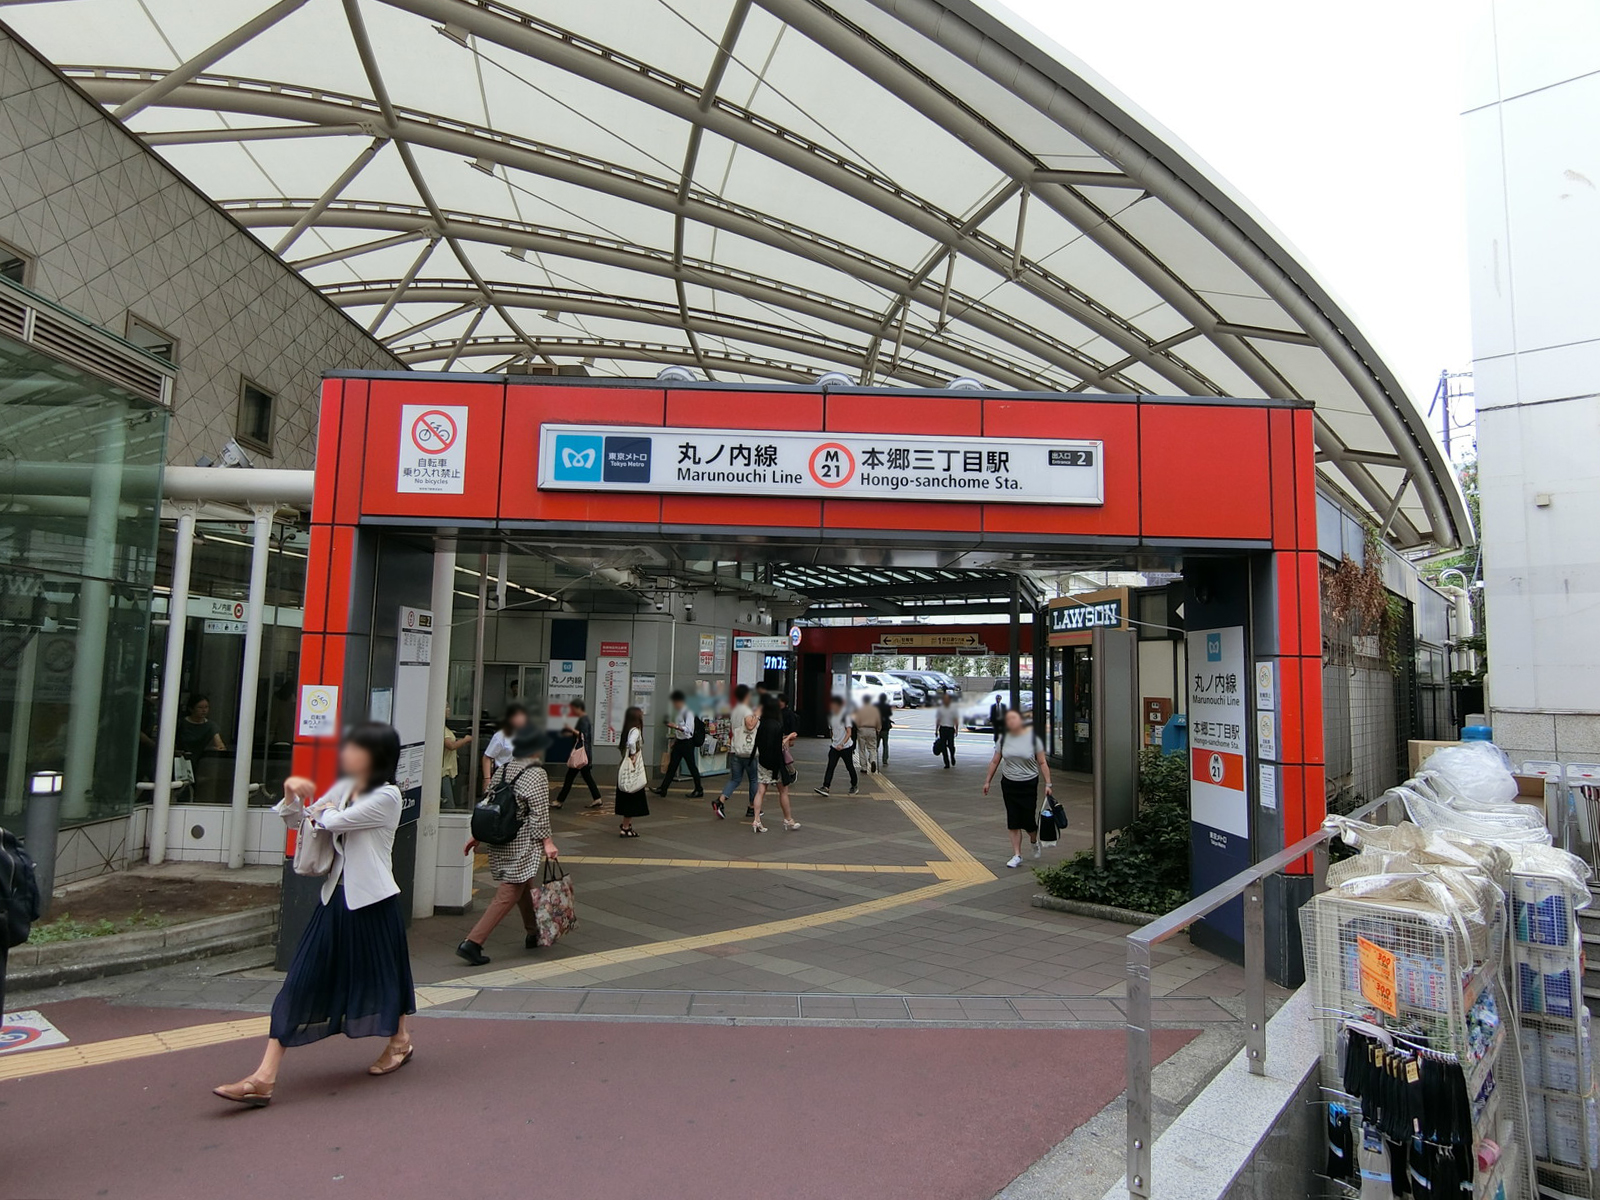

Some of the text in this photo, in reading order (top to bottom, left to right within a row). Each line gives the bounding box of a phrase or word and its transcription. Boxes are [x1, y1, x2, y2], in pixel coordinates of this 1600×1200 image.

[608, 452, 647, 461] 東京メトロ
[677, 442, 778, 467] 丸ノ内線
[825, 450, 839, 462] M
[861, 447, 1009, 473] 本郷三丁目駅
[1077, 452, 1086, 465] 2
[418, 458, 447, 467] 自転車
[403, 467, 461, 478] 乗り入れ禁止
[677, 468, 803, 484] Marunouchi Line
[821, 464, 840, 478] 21
[860, 473, 1023, 490] Hongo-sanchome Sta.
[1053, 603, 1117, 630] LAWSON
[551, 676, 583, 684] 丸ノ内線
[1194, 673, 1237, 693] 丸ノ内線
[1193, 694, 1240, 706] Marunouchi Line
[1193, 721, 1240, 739] 本郷三丁目駅
[1212, 766, 1220, 778] 21
